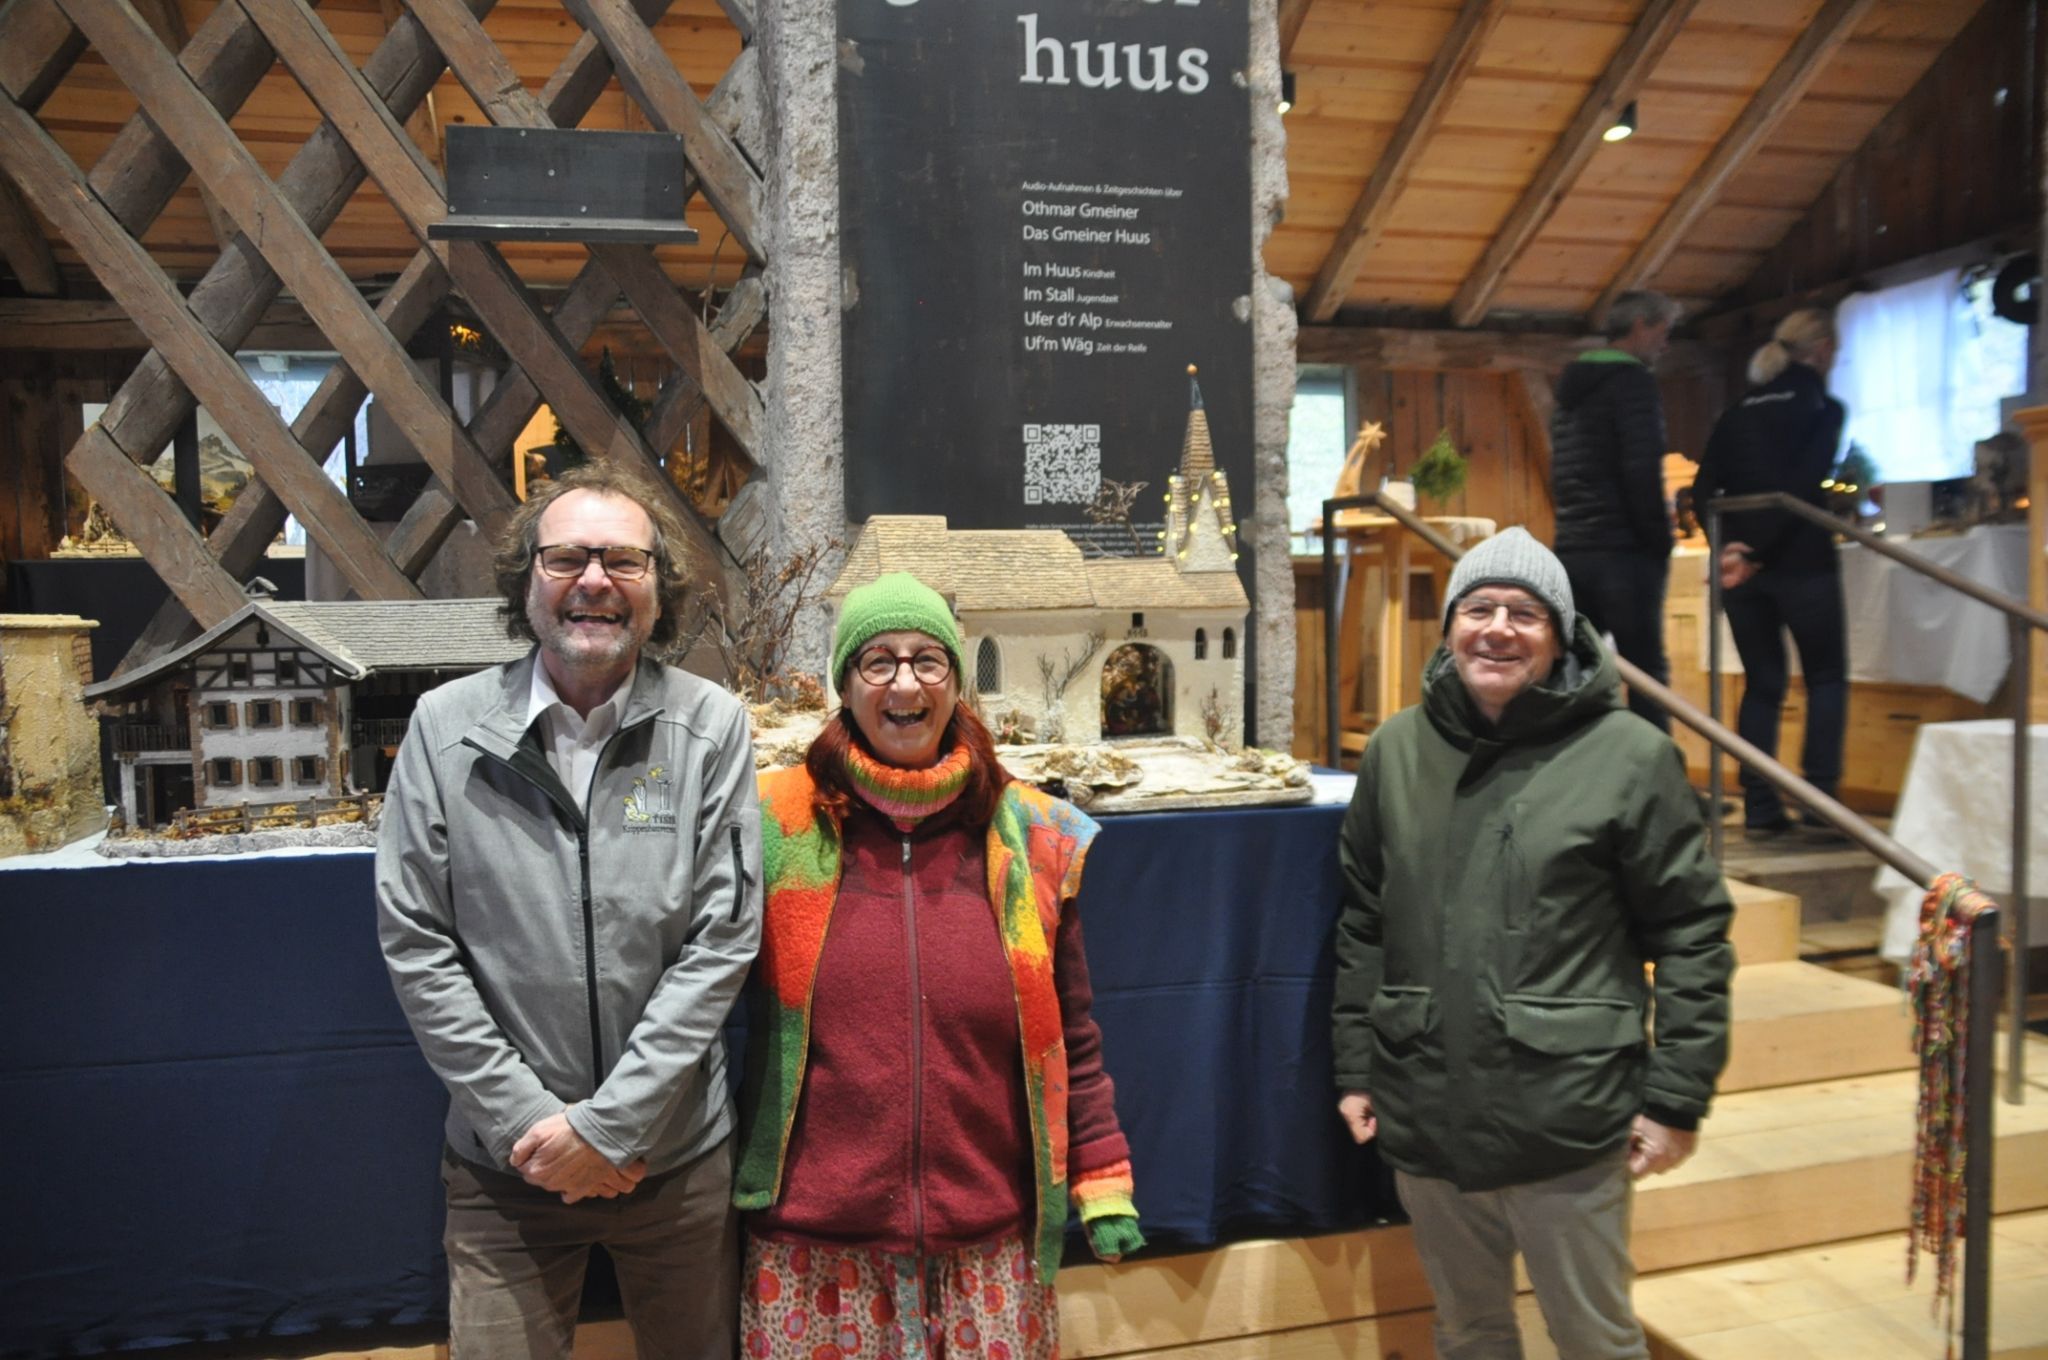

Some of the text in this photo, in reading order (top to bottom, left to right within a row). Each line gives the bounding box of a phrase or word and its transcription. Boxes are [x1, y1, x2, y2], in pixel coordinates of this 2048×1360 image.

[1016, 13, 1209, 93] huus
[1022, 200, 1140, 219] Othmar Gmeiner
[1022, 225, 1151, 244] Das Gmeiner Huus
[1023, 261, 1116, 279] Im Huus Kindheit
[1023, 286, 1119, 304] Im Stall Jugendzeit
[1024, 310, 1054, 326] Ufer
[1078, 312, 1103, 330] Alp
[1062, 336, 1093, 355] Wäg
